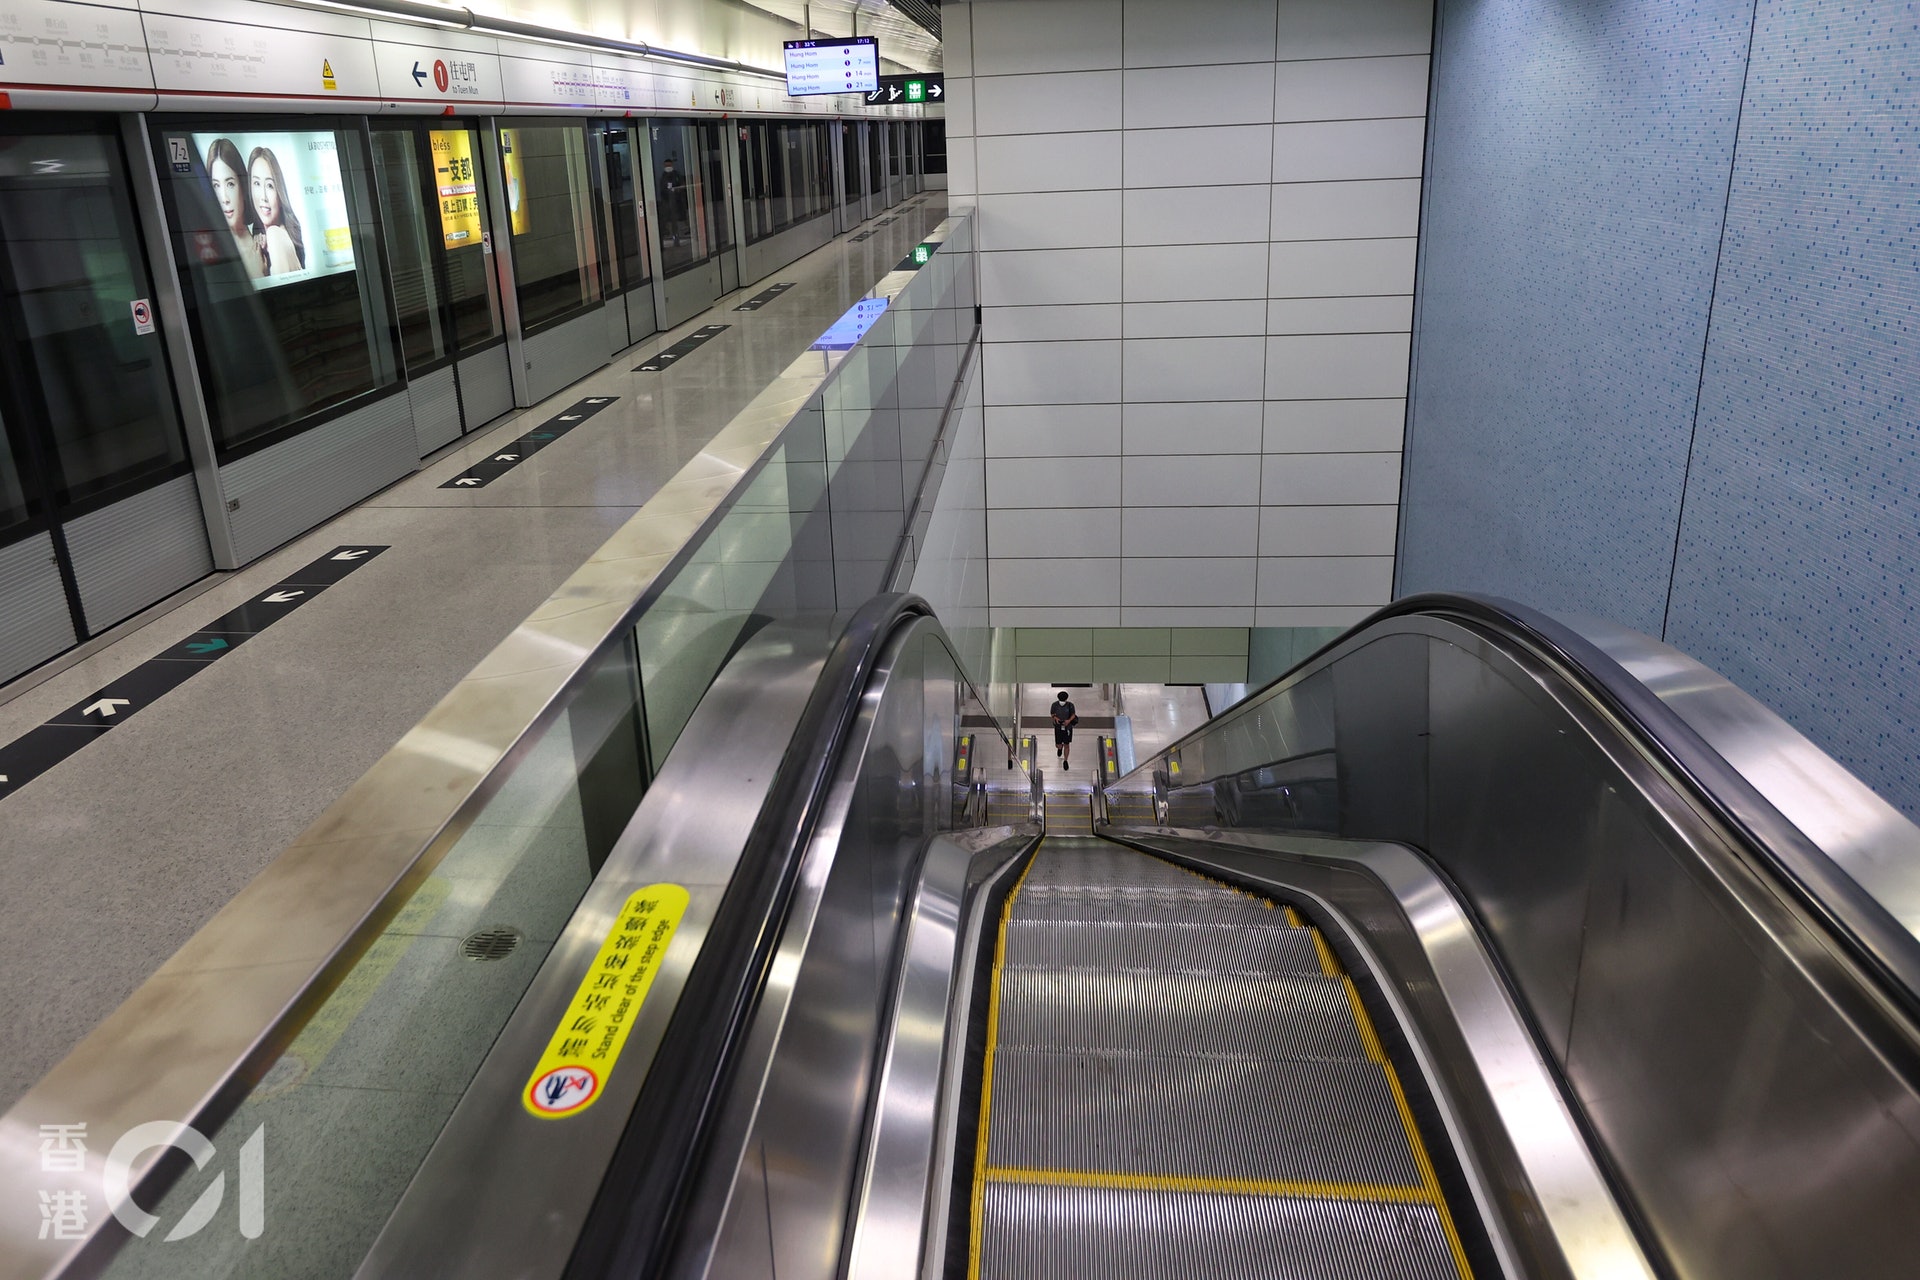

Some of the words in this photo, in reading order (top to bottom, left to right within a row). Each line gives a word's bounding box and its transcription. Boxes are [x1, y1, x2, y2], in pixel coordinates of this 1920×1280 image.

[450, 60, 476, 82] 往屯門
[458, 85, 468, 94] Tuen
[468, 86, 478, 94] Mun
[171, 142, 188, 160] 7-2
[652, 918, 671, 942] edge
[641, 943, 659, 965] step
[558, 900, 660, 1058] 請勿站近梯級邊緣
[630, 966, 648, 983] the
[626, 983, 638, 996] of
[612, 997, 632, 1024] clear
[592, 1024, 619, 1060] Stand
